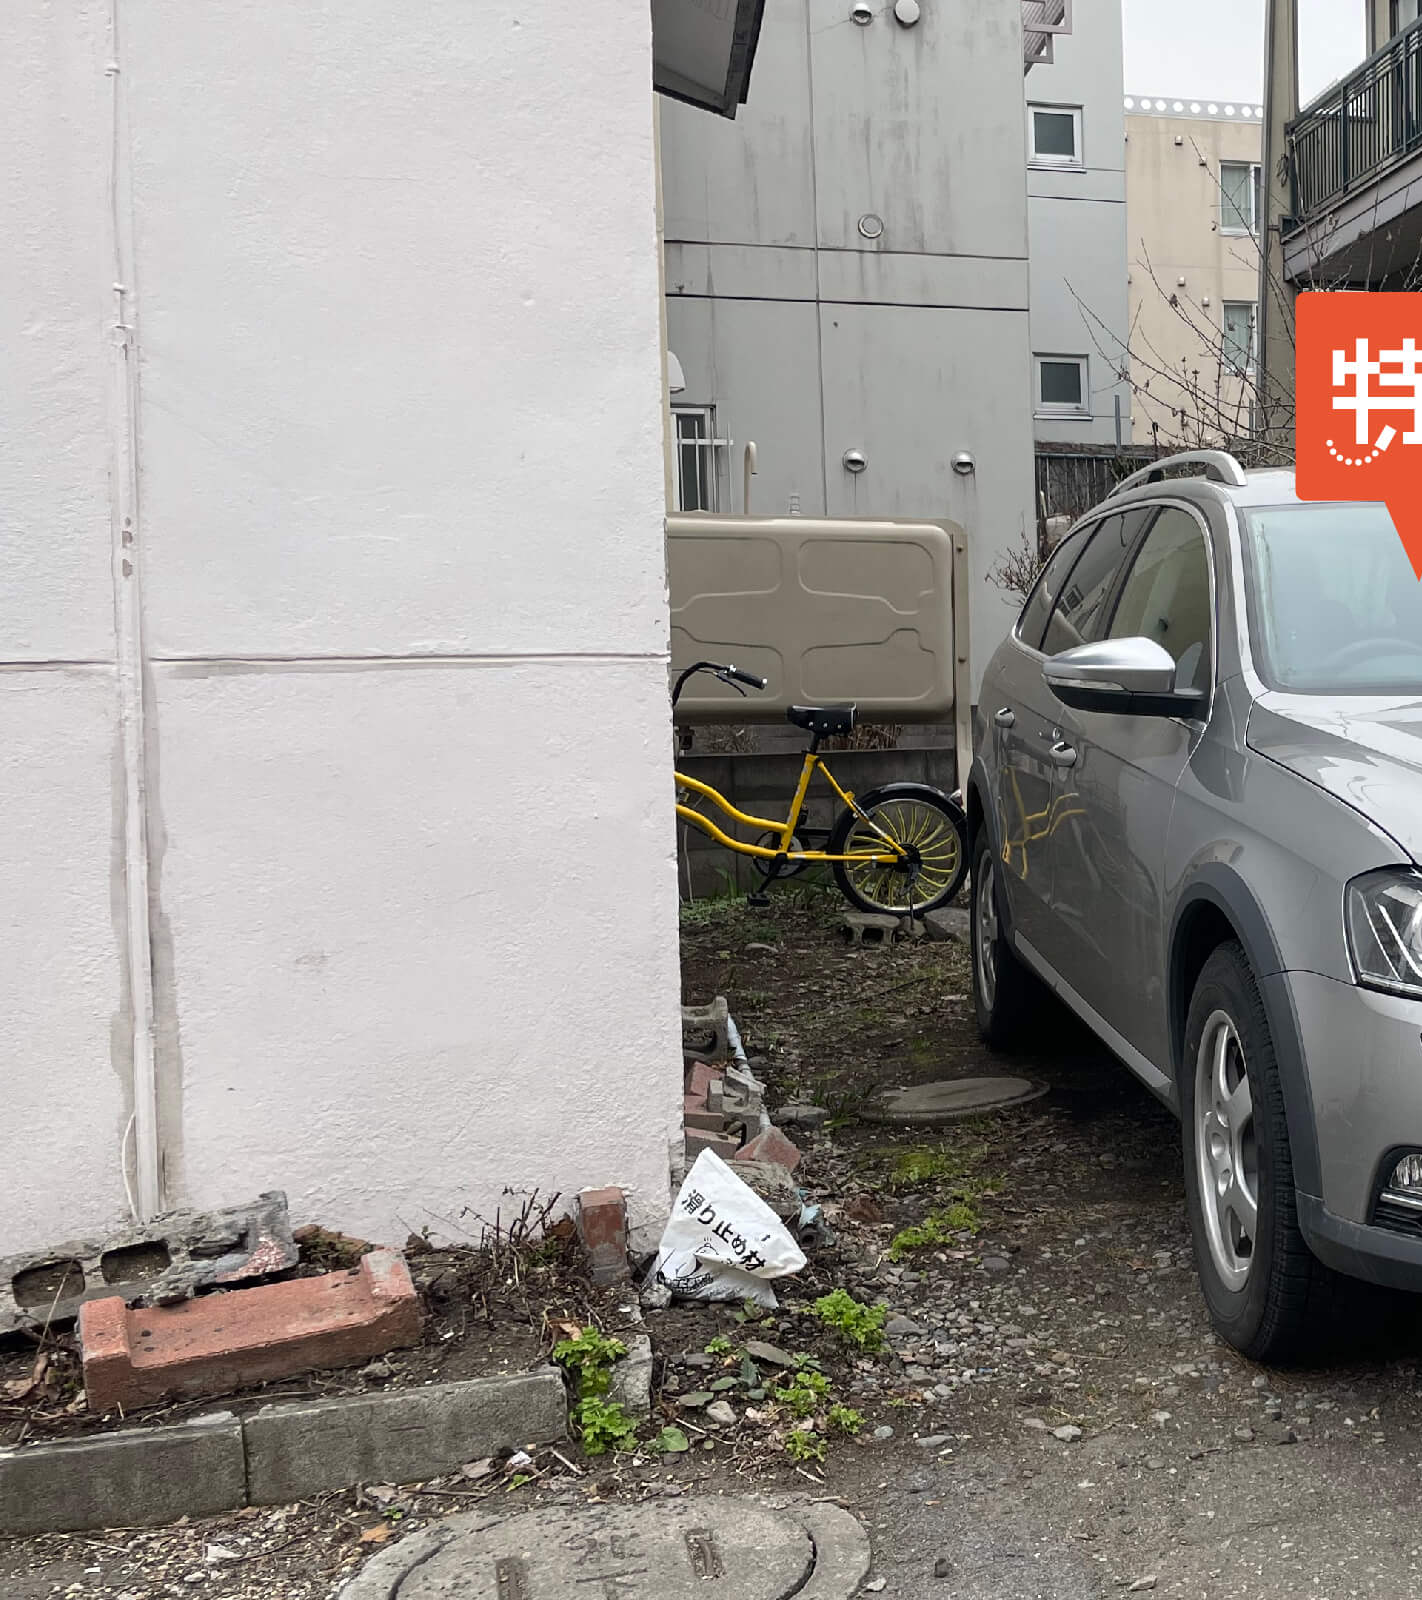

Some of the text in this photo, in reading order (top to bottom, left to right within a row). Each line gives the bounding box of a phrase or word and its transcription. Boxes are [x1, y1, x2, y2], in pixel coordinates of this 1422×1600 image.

[681, 1189, 766, 1271] 滑り止め材
